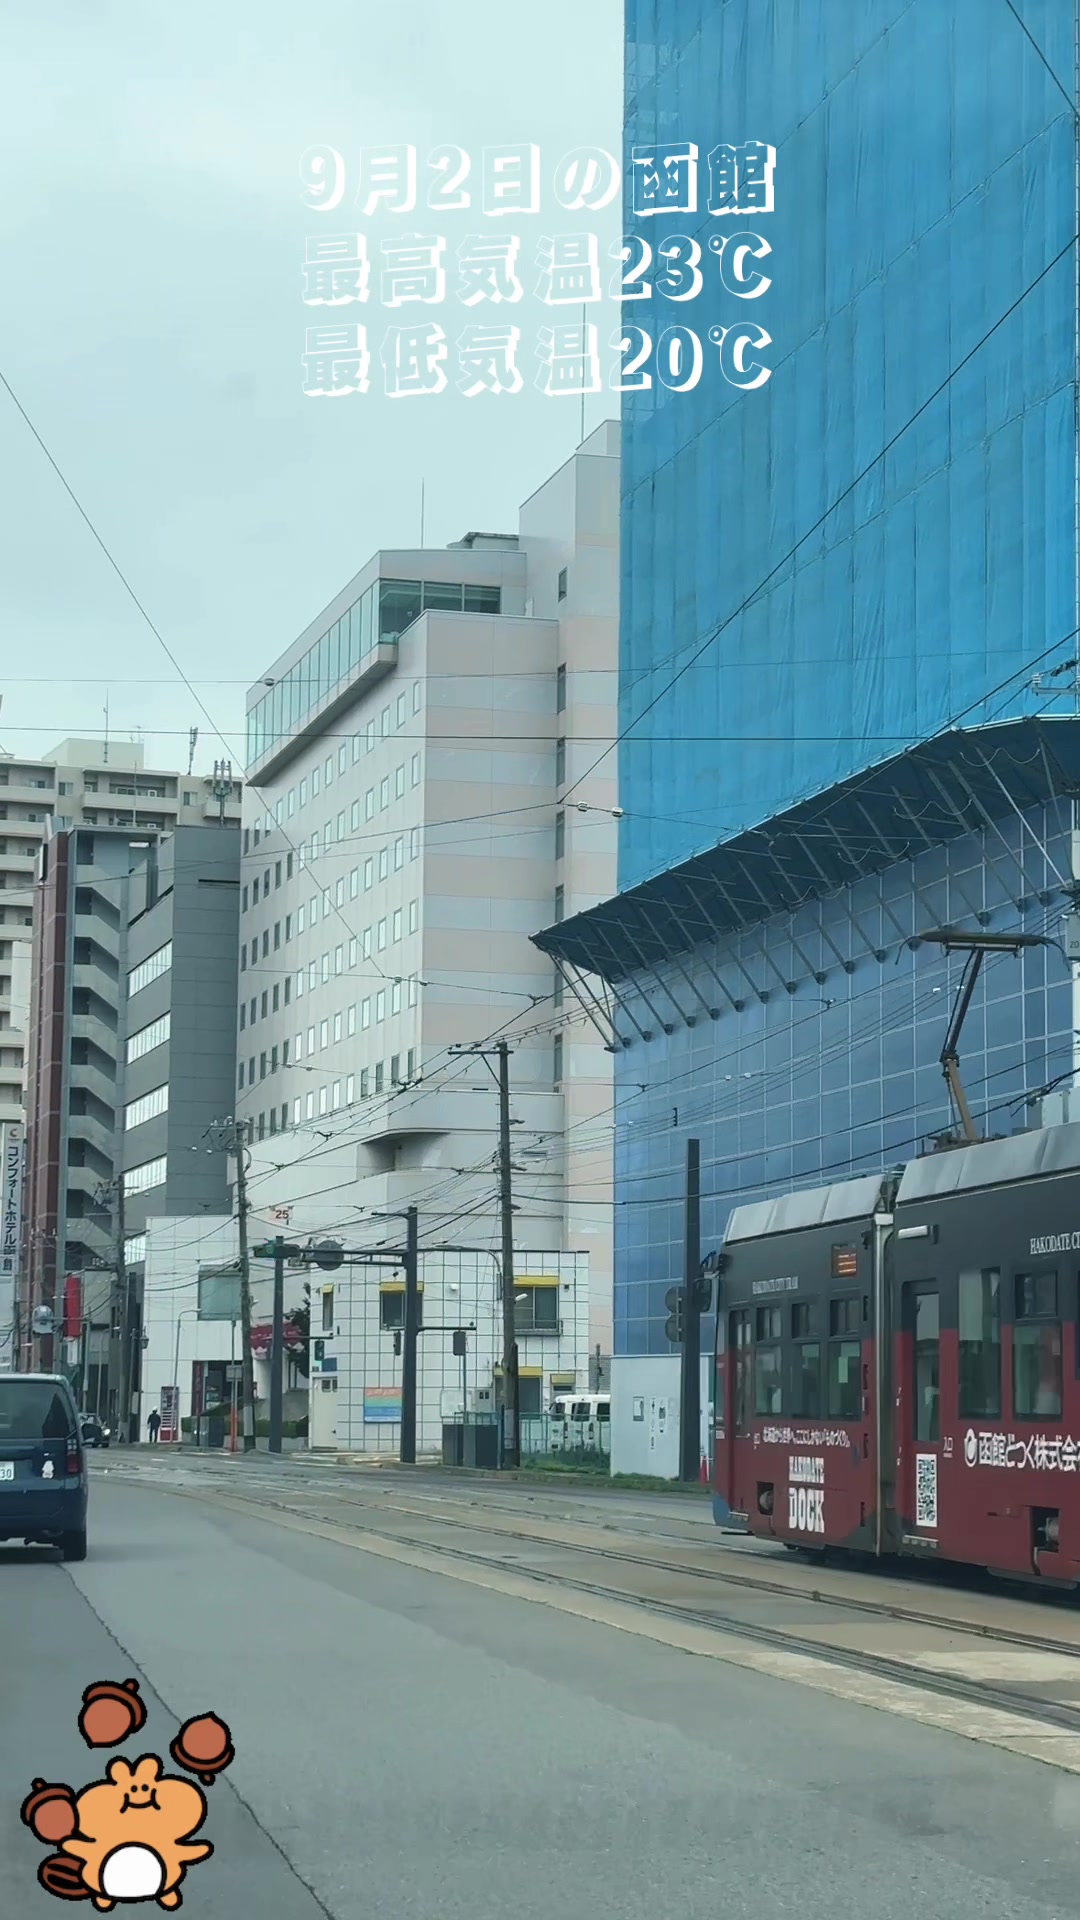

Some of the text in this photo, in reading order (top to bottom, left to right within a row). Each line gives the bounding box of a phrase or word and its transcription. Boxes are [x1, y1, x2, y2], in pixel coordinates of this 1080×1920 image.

[3, 1145, 19, 1271] コンフォートホテル函館
[275, 1209, 290, 1220] 25
[1030, 1233, 1070, 1254] HAKODATE
[979, 1431, 1080, 1472] 函館どつく株式会
[788, 1487, 825, 1533] DOCK
